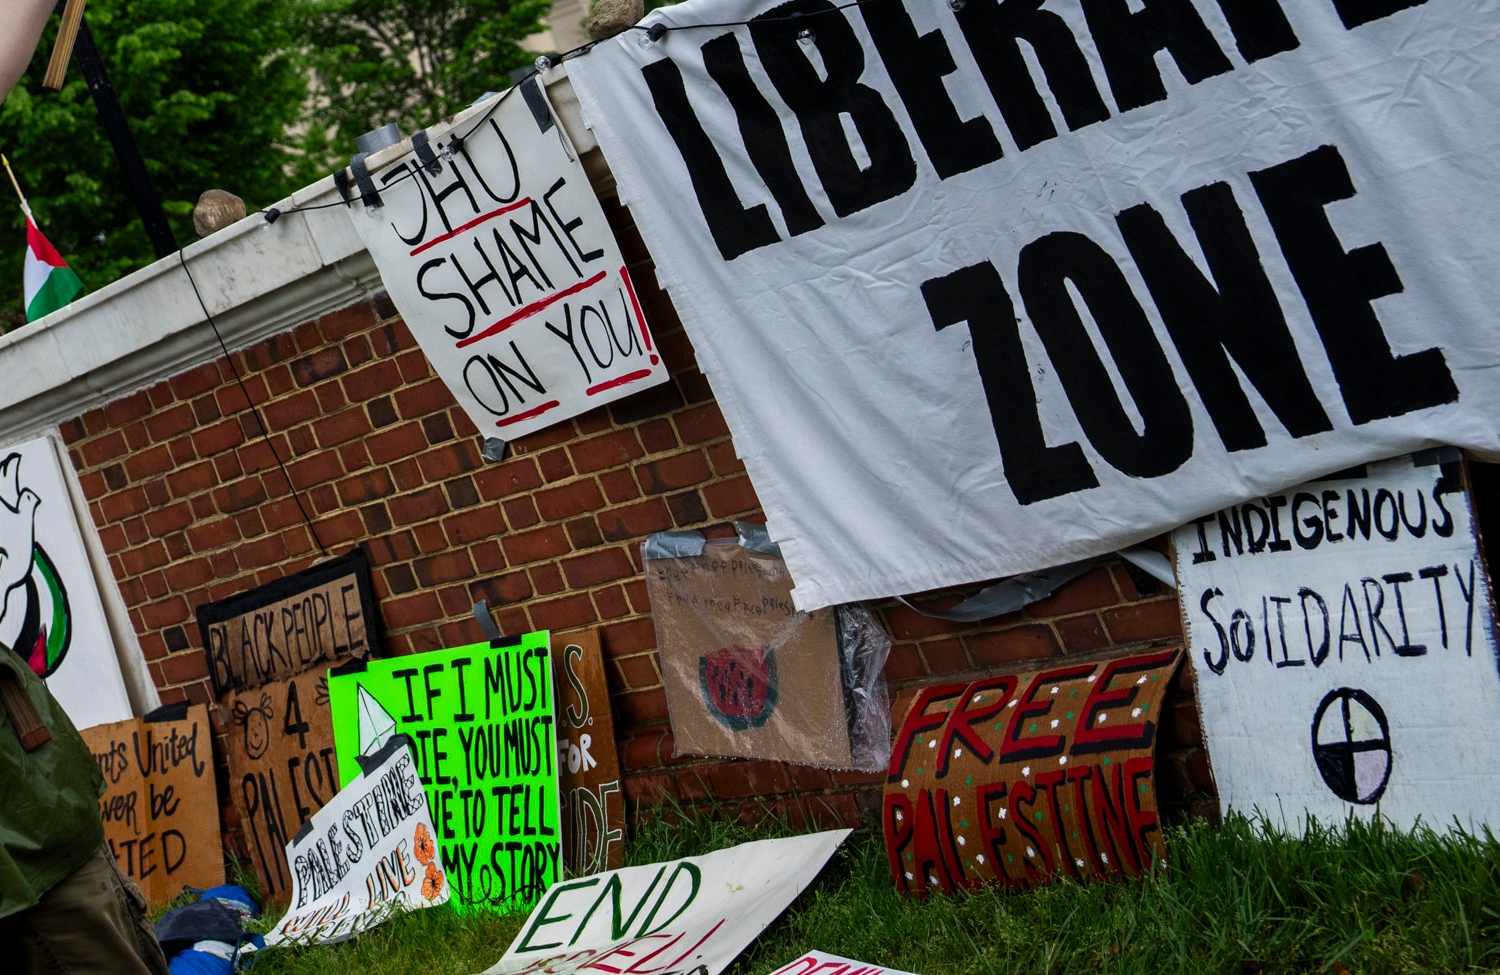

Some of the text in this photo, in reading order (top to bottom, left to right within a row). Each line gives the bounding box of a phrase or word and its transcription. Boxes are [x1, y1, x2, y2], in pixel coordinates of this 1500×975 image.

[379, 118, 521, 246] JHU
[416, 177, 605, 339] SHAME
[462, 265, 660, 416] ON YOU!
[920, 144, 1460, 506] ZONE
[1188, 477, 1454, 564] INDIGENOUS
[210, 583, 364, 692] BLACK PEOPLE
[284, 680, 309, 749] 4
[392, 647, 549, 724] IF I MUST
[553, 644, 594, 729] .S.
[888, 649, 1180, 784] FREE
[93, 722, 205, 784] nts United
[458, 723, 501, 786] YOU
[503, 715, 553, 779] MUST
[558, 733, 597, 777] FOR
[150, 784, 180, 821] be
[295, 753, 424, 910] PALESTINE
[425, 783, 555, 839] VE TO TELL
[560, 780, 622, 877] IDE
[884, 756, 1160, 899] PALESTINE
[279, 838, 416, 935] WILL LIVE
[442, 841, 560, 905] MY STORY
[514, 861, 702, 954] END
